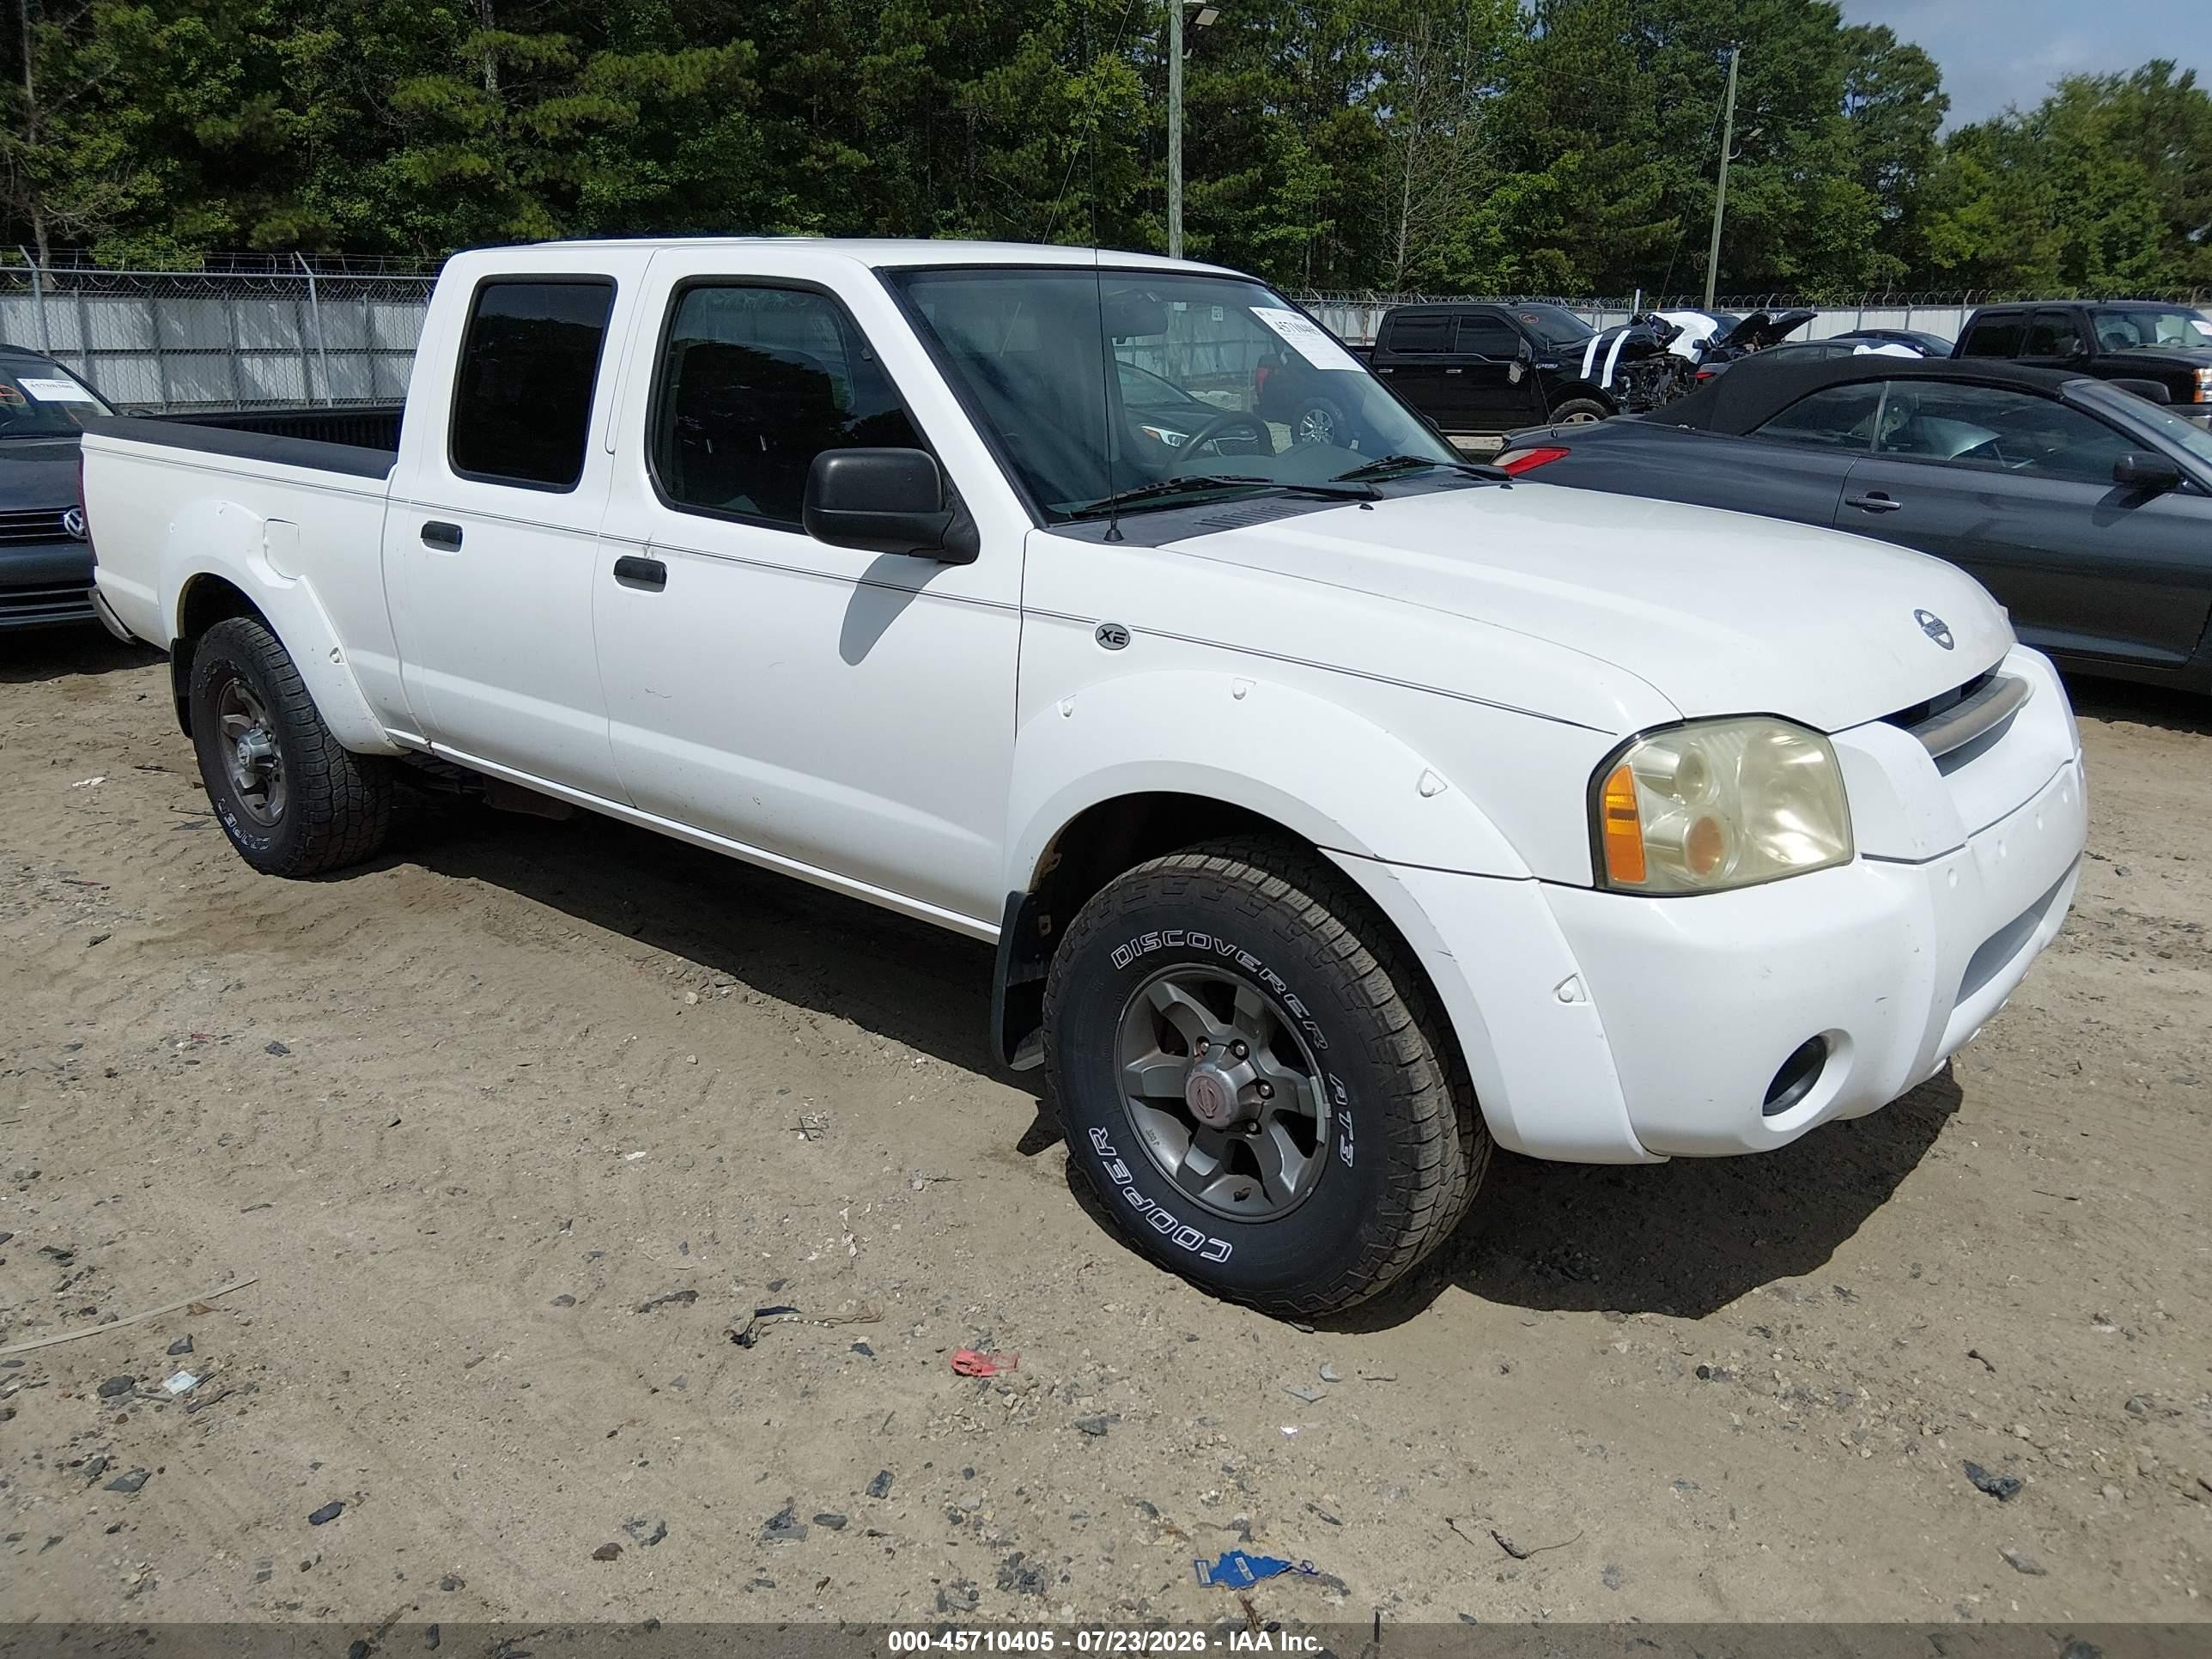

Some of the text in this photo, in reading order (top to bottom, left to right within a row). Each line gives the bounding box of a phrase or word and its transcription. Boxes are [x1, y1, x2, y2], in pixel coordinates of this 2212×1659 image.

[1098, 628, 1127, 645] XE
[1110, 929, 1354, 1169] DISCOVERER AT3
[1088, 1126, 1233, 1263] COOPER
